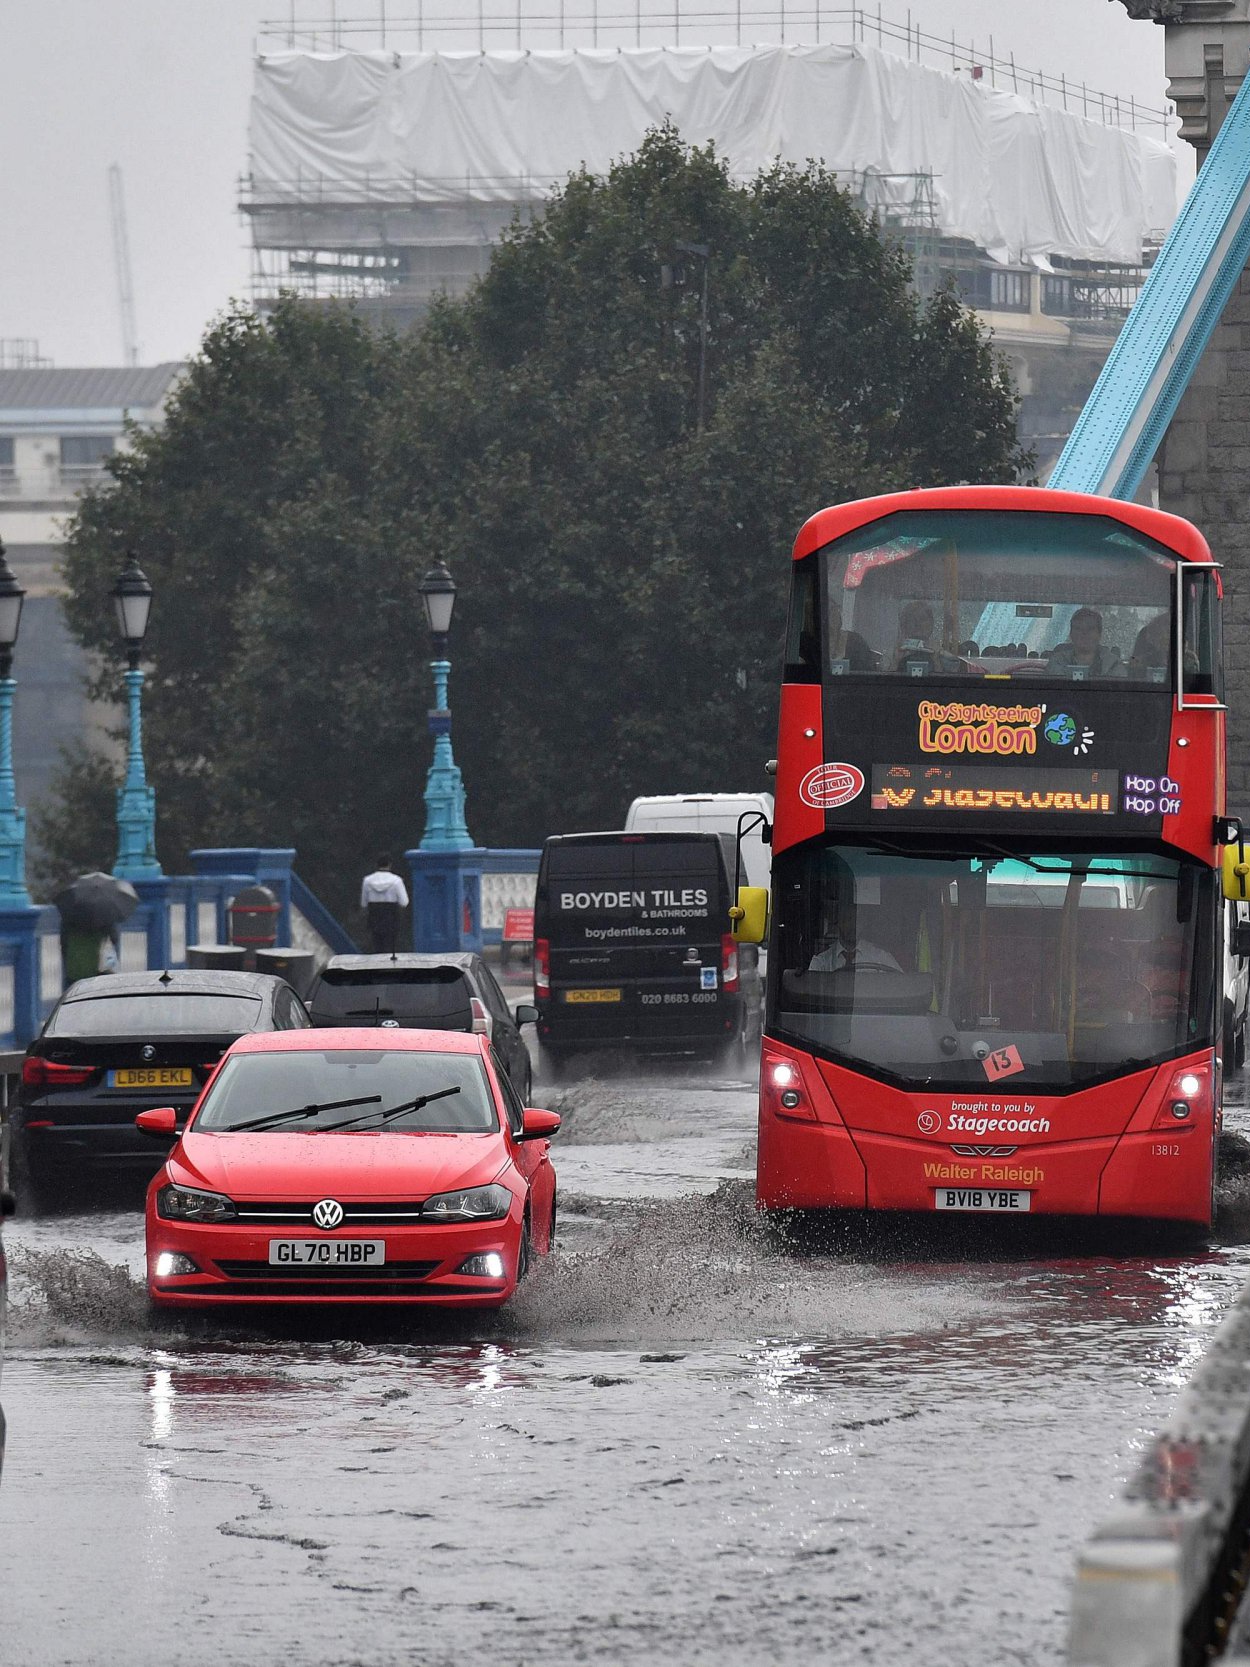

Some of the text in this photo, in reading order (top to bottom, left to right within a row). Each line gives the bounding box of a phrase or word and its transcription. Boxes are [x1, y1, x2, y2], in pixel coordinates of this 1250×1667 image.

[919, 701, 1042, 724] CitySightseeing
[919, 717, 1037, 754] London
[810, 777, 851, 794] OFFICIAL
[1126, 776, 1179, 794] Hop On
[1126, 796, 1181, 814] Hop Off
[561, 889, 708, 909] BOYDEN TILES
[641, 908, 709, 918] & BATHROOMS
[585, 925, 687, 940] boydentiles.co.uk
[641, 994, 660, 1004] 020
[990, 1050, 1012, 1072] 13
[117, 1069, 189, 1084] LD66 EKL
[951, 1101, 1035, 1115] brought to you by
[947, 1114, 1050, 1135] Stagecoach
[1151, 1144, 1180, 1156] 13812
[923, 1163, 1045, 1184] Walter Raleigh
[945, 1191, 1020, 1208] BV18 YBE
[277, 1243, 376, 1263] GL70 HBP
